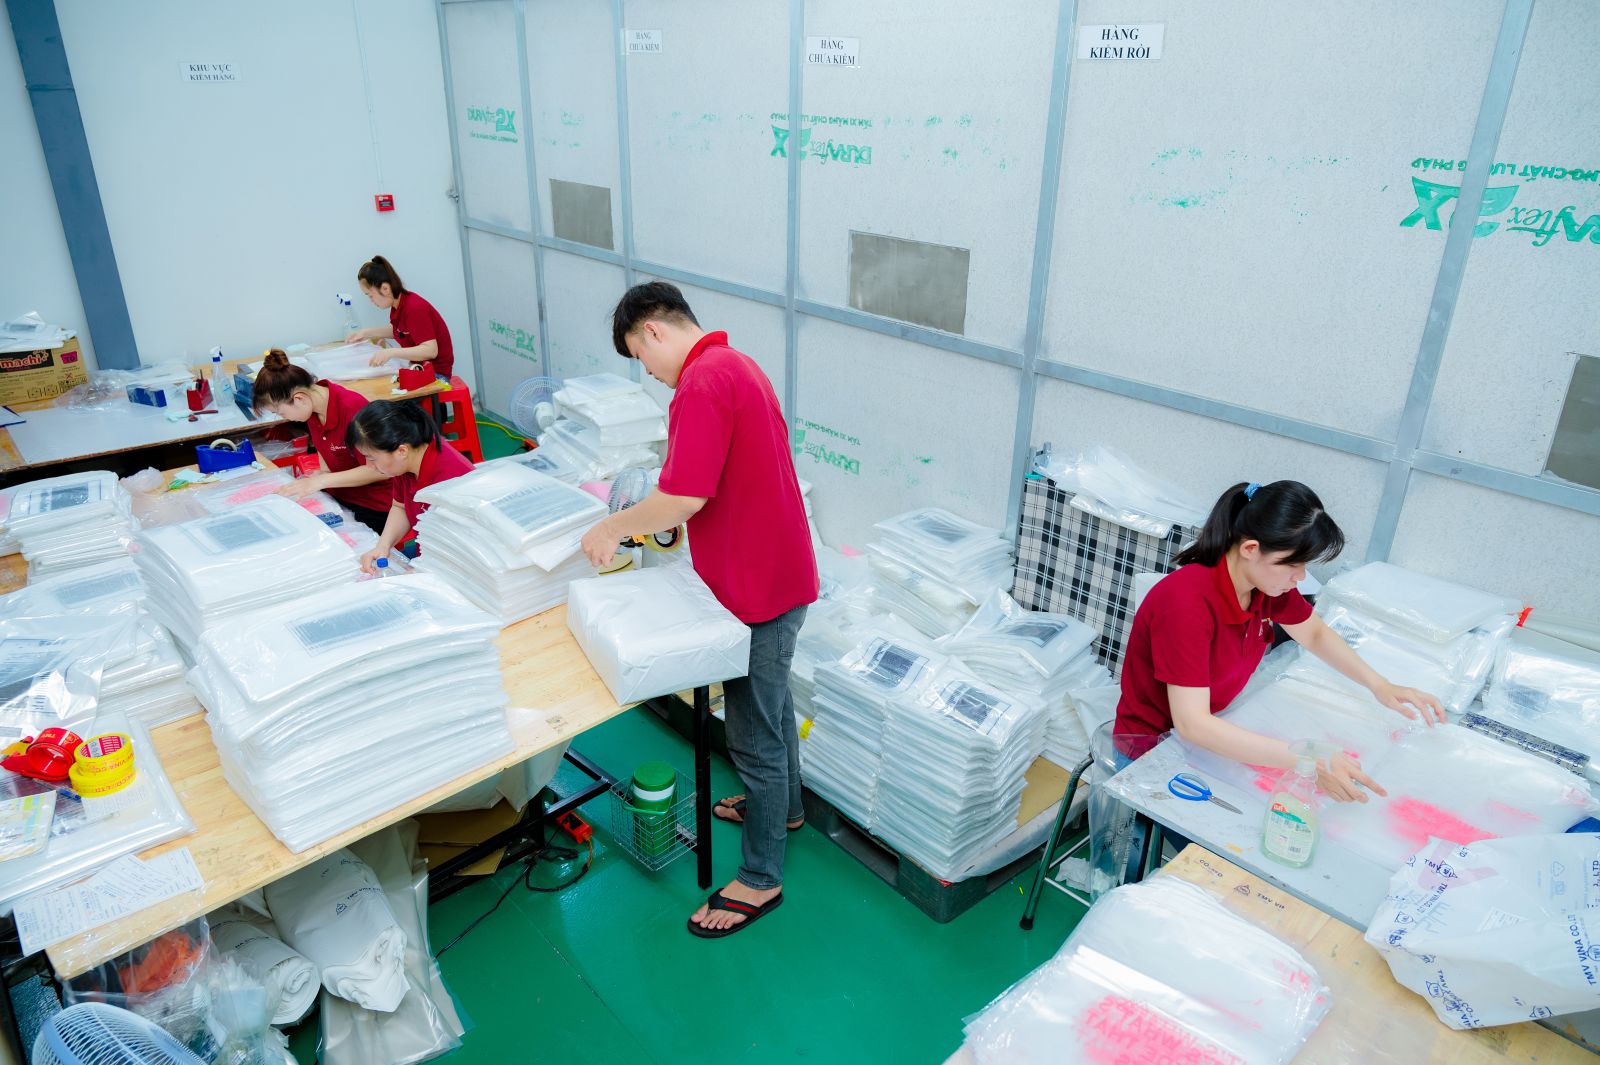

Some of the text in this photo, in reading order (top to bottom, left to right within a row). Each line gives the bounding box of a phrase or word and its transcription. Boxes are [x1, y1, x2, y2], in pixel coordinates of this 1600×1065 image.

[1101, 25, 1140, 40] HÀNG
[1574, 939, 1587, 962] VINA
[1581, 965, 1597, 986] TMV
